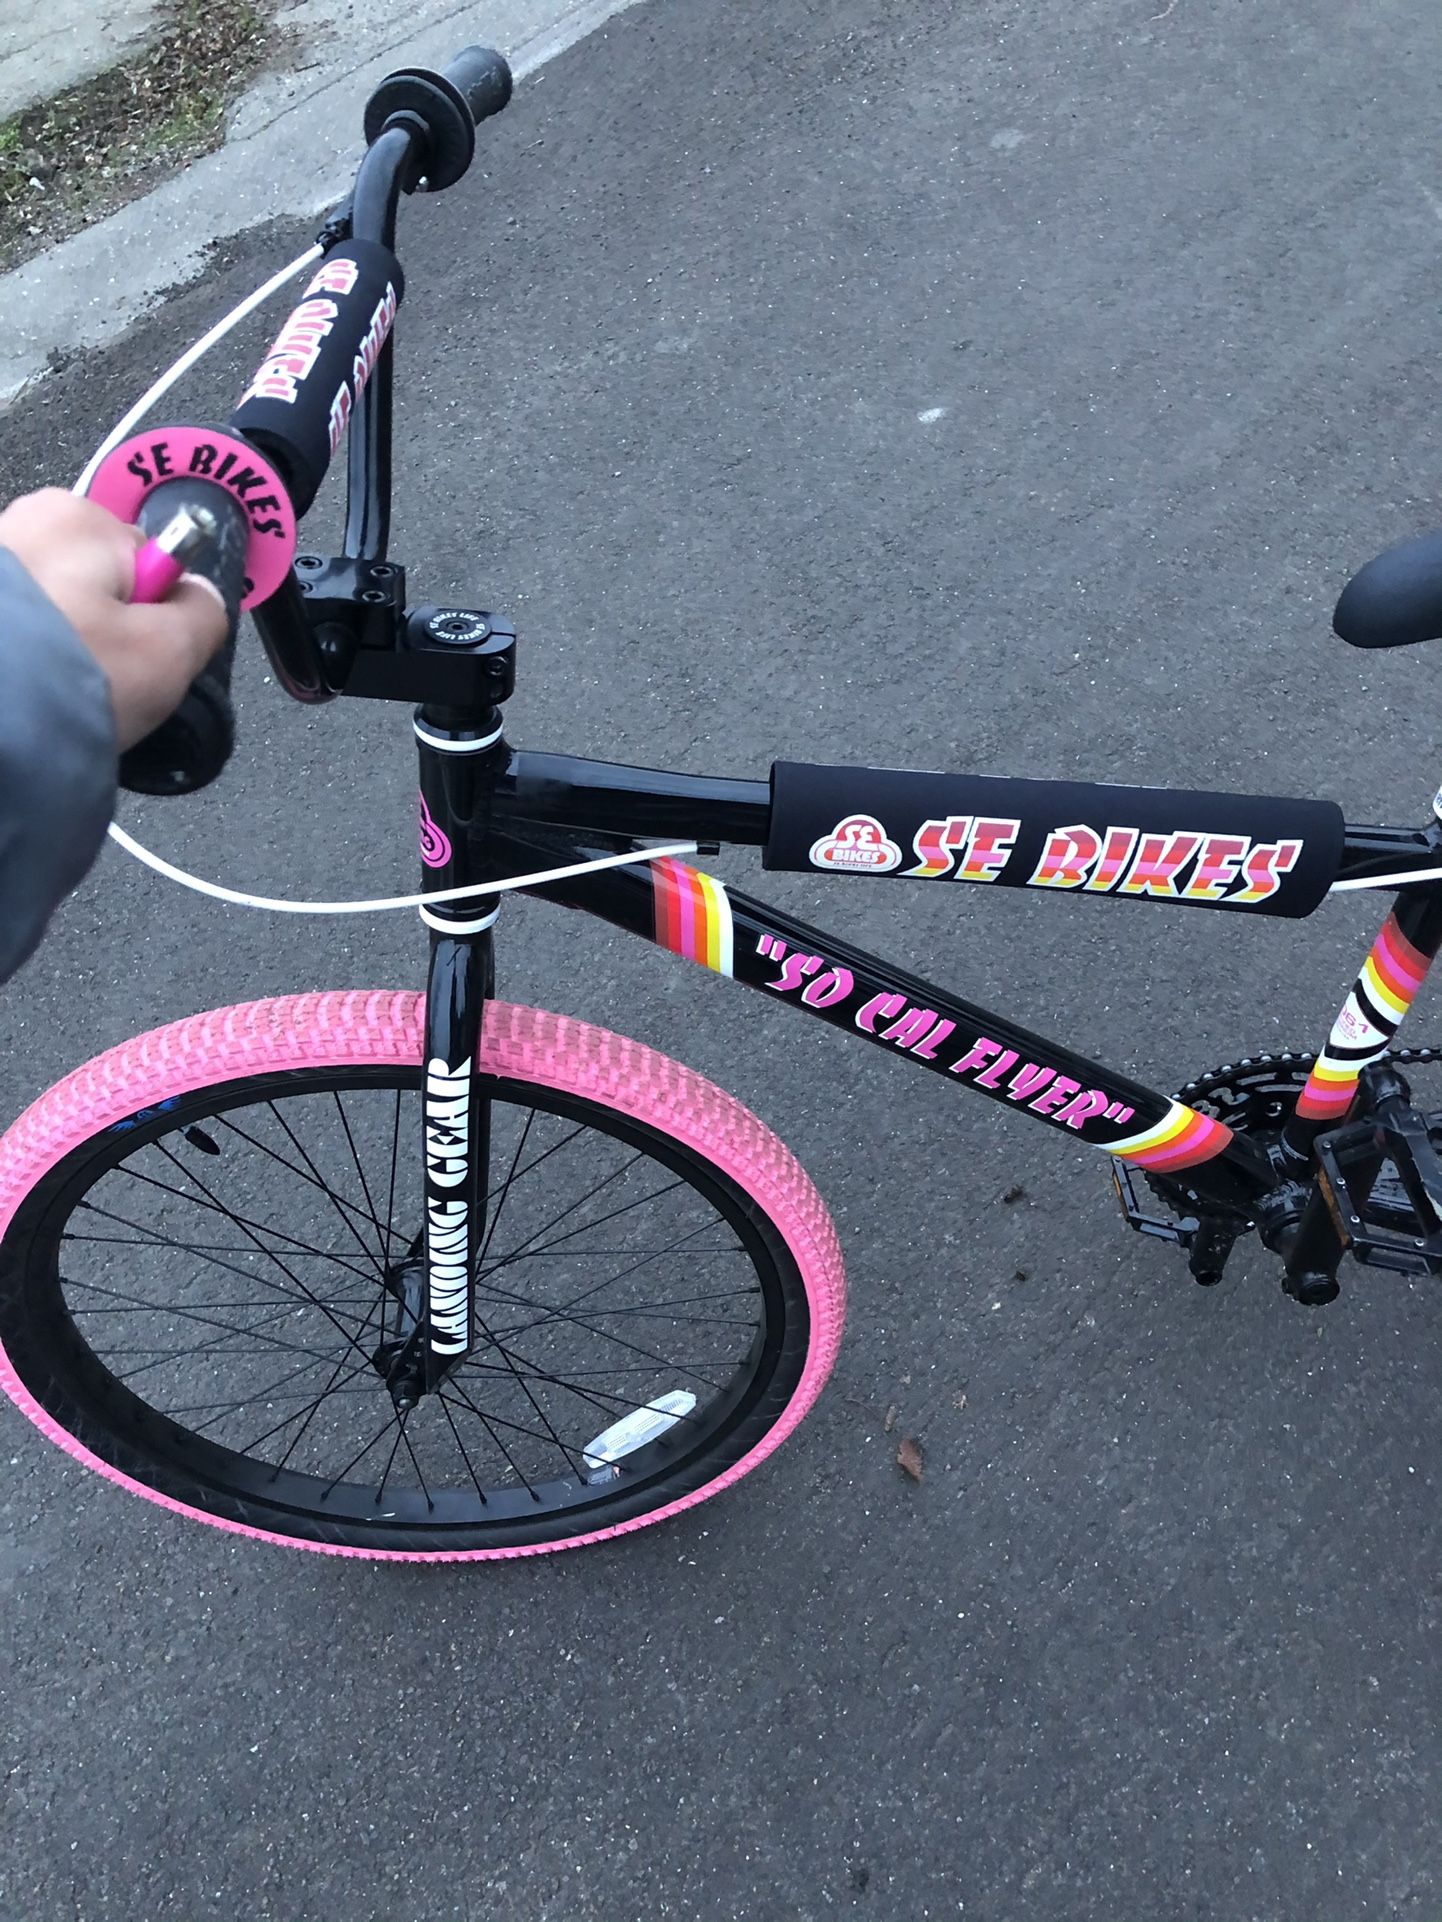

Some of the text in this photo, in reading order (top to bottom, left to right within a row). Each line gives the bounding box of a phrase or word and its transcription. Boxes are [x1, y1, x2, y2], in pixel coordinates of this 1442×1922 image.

[126, 442, 286, 539] SE BIKES
[832, 849, 881, 864] BIKES
[835, 824, 878, 851] SE
[896, 815, 1303, 904] SE BIKES
[855, 991, 957, 1060] CAL
[426, 1055, 471, 1355] LANDING GEAR
